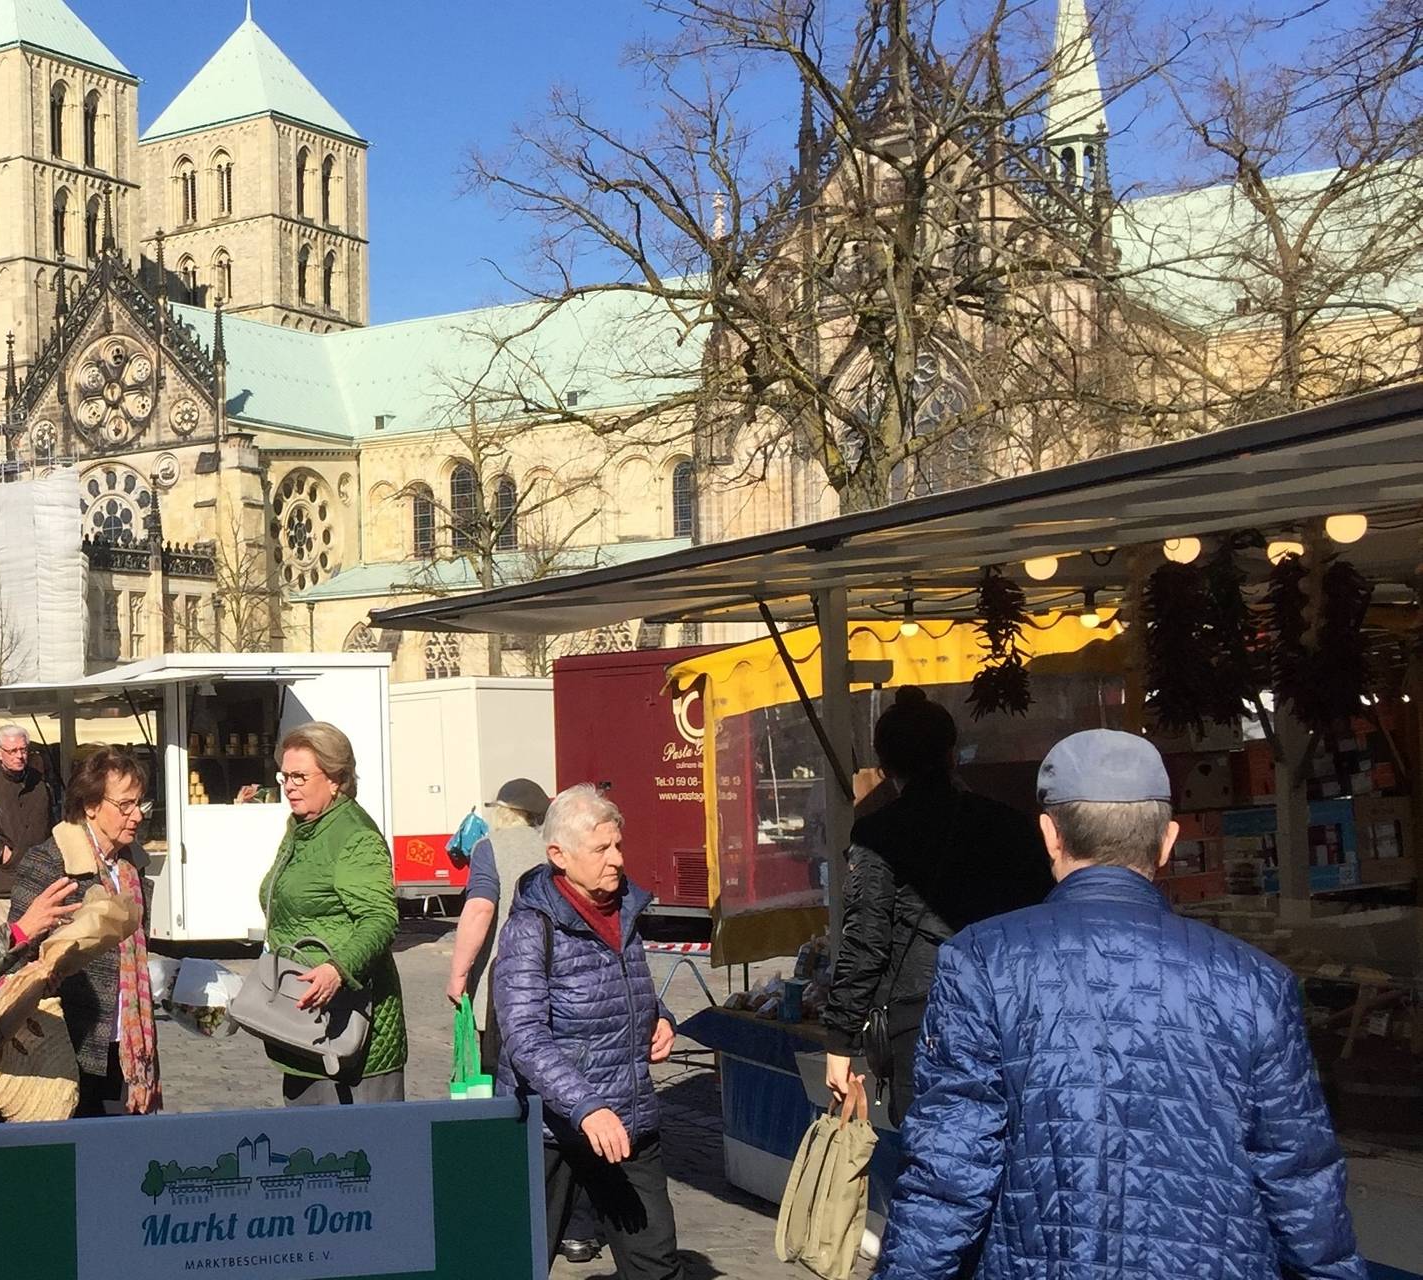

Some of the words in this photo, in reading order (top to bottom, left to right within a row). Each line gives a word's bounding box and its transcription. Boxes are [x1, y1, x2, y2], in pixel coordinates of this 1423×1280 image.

[662, 742, 693, 762] Pasta
[141, 1212, 238, 1246] Markt
[247, 1215, 295, 1238] am
[304, 1203, 372, 1236] Dom
[185, 1253, 304, 1270] MARKTBESCHICKER
